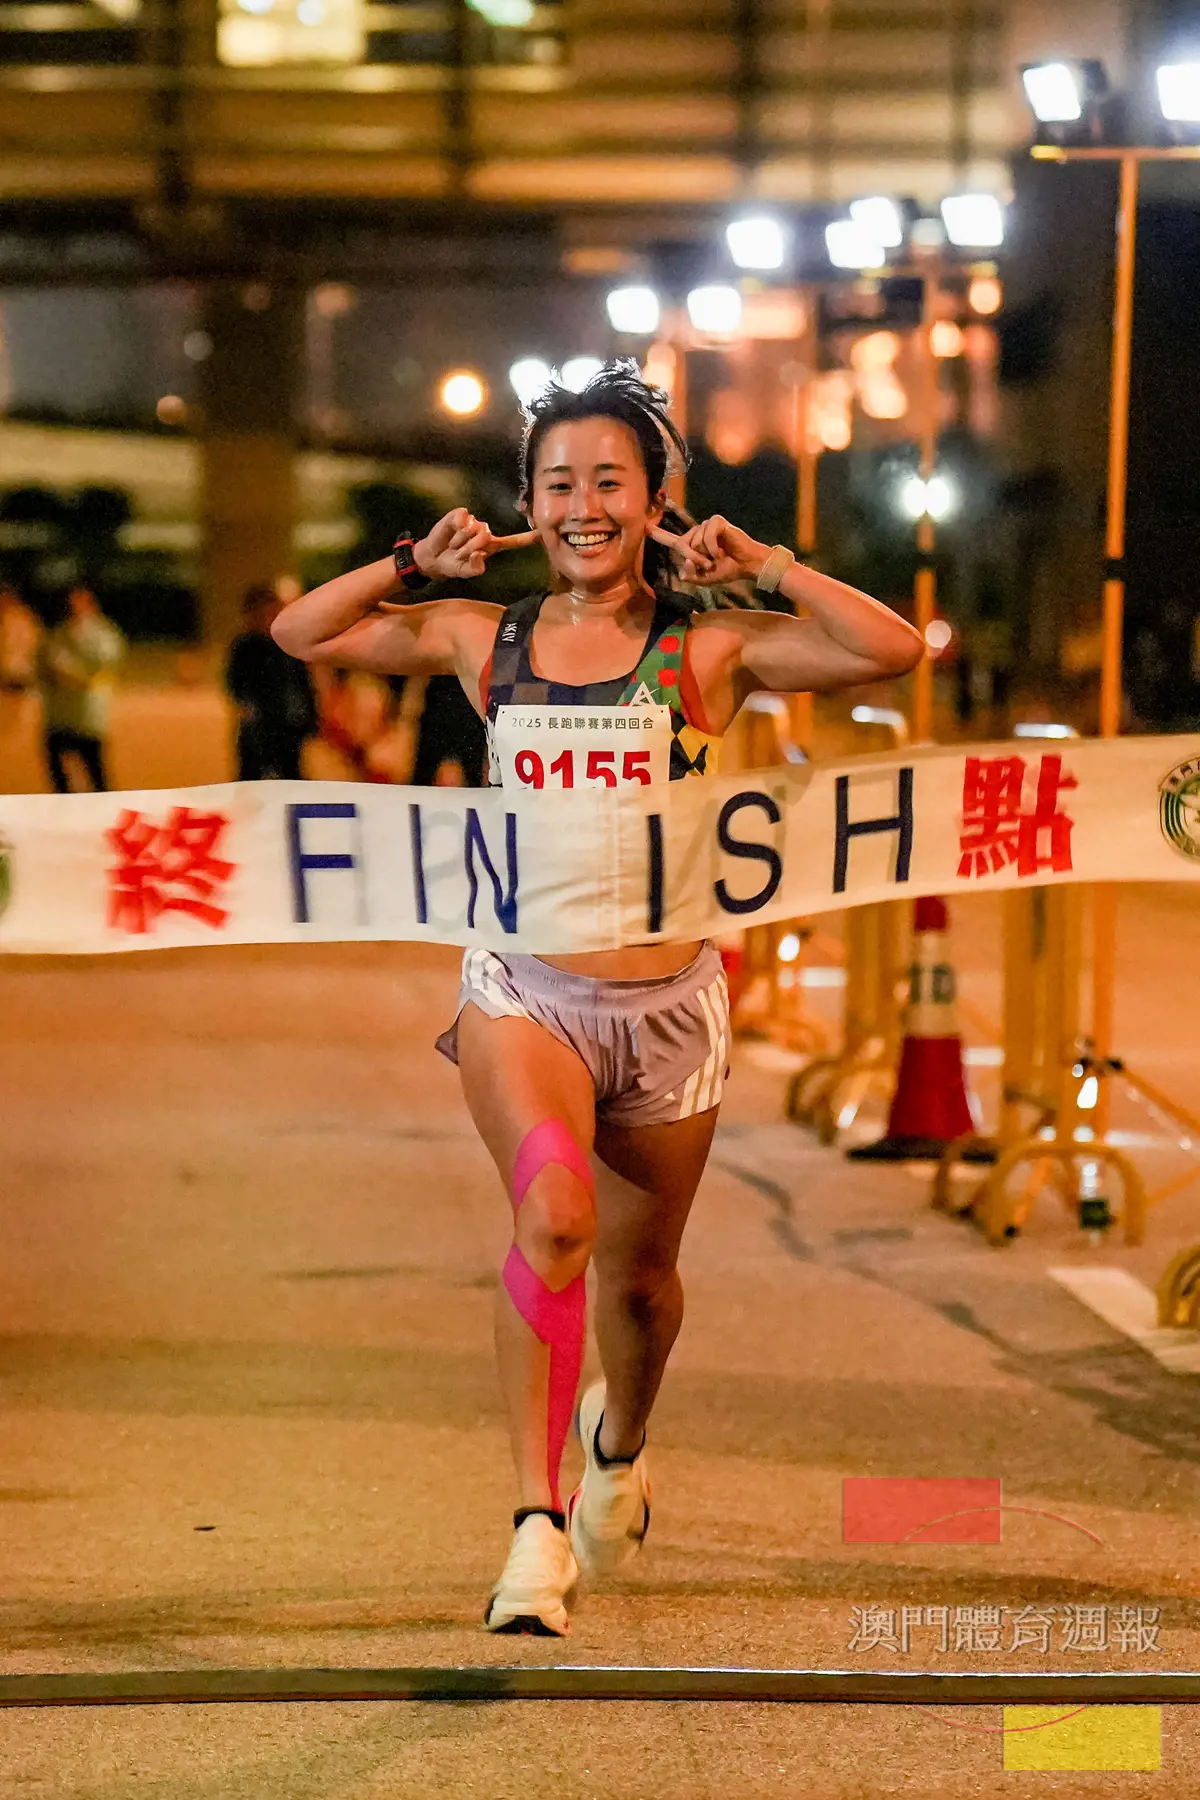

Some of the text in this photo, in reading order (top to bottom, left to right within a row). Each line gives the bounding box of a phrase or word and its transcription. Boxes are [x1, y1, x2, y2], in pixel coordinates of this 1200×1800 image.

[512, 716, 655, 730] 2025 長跑聯賽第四回合
[514, 749, 652, 790] 9155
[104, 805, 239, 934] 終
[956, 752, 1079, 879] 點
